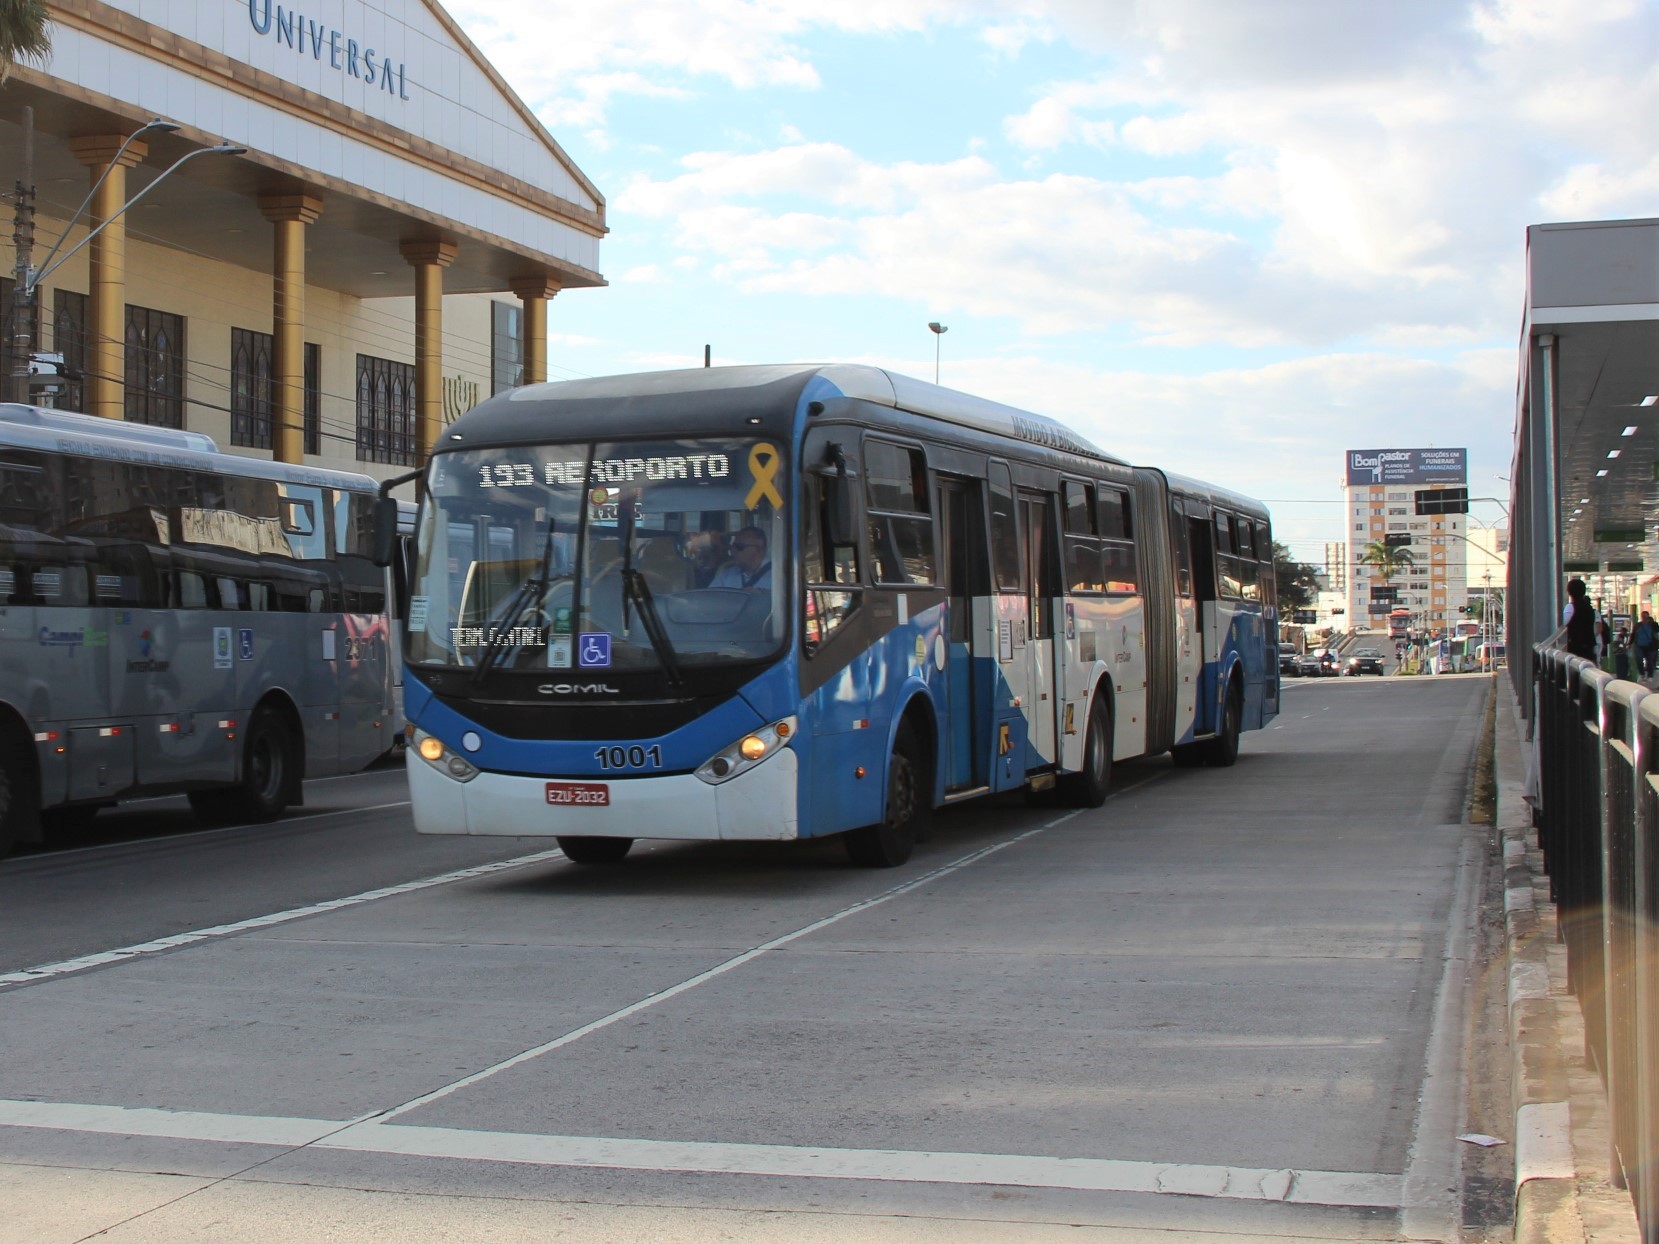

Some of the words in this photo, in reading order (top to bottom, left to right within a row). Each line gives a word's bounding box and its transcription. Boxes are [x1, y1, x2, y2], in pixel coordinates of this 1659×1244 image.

[249, 0, 409, 101] UNIVERSAL
[1011, 415, 1048, 445] MOVIDO
[479, 464, 535, 488] 193
[544, 454, 730, 485] AEROPORTO
[1355, 454, 1378, 467] Bom
[538, 684, 620, 694] COMIL
[594, 744, 663, 770] 1001
[548, 790, 607, 803] EZU-2032
